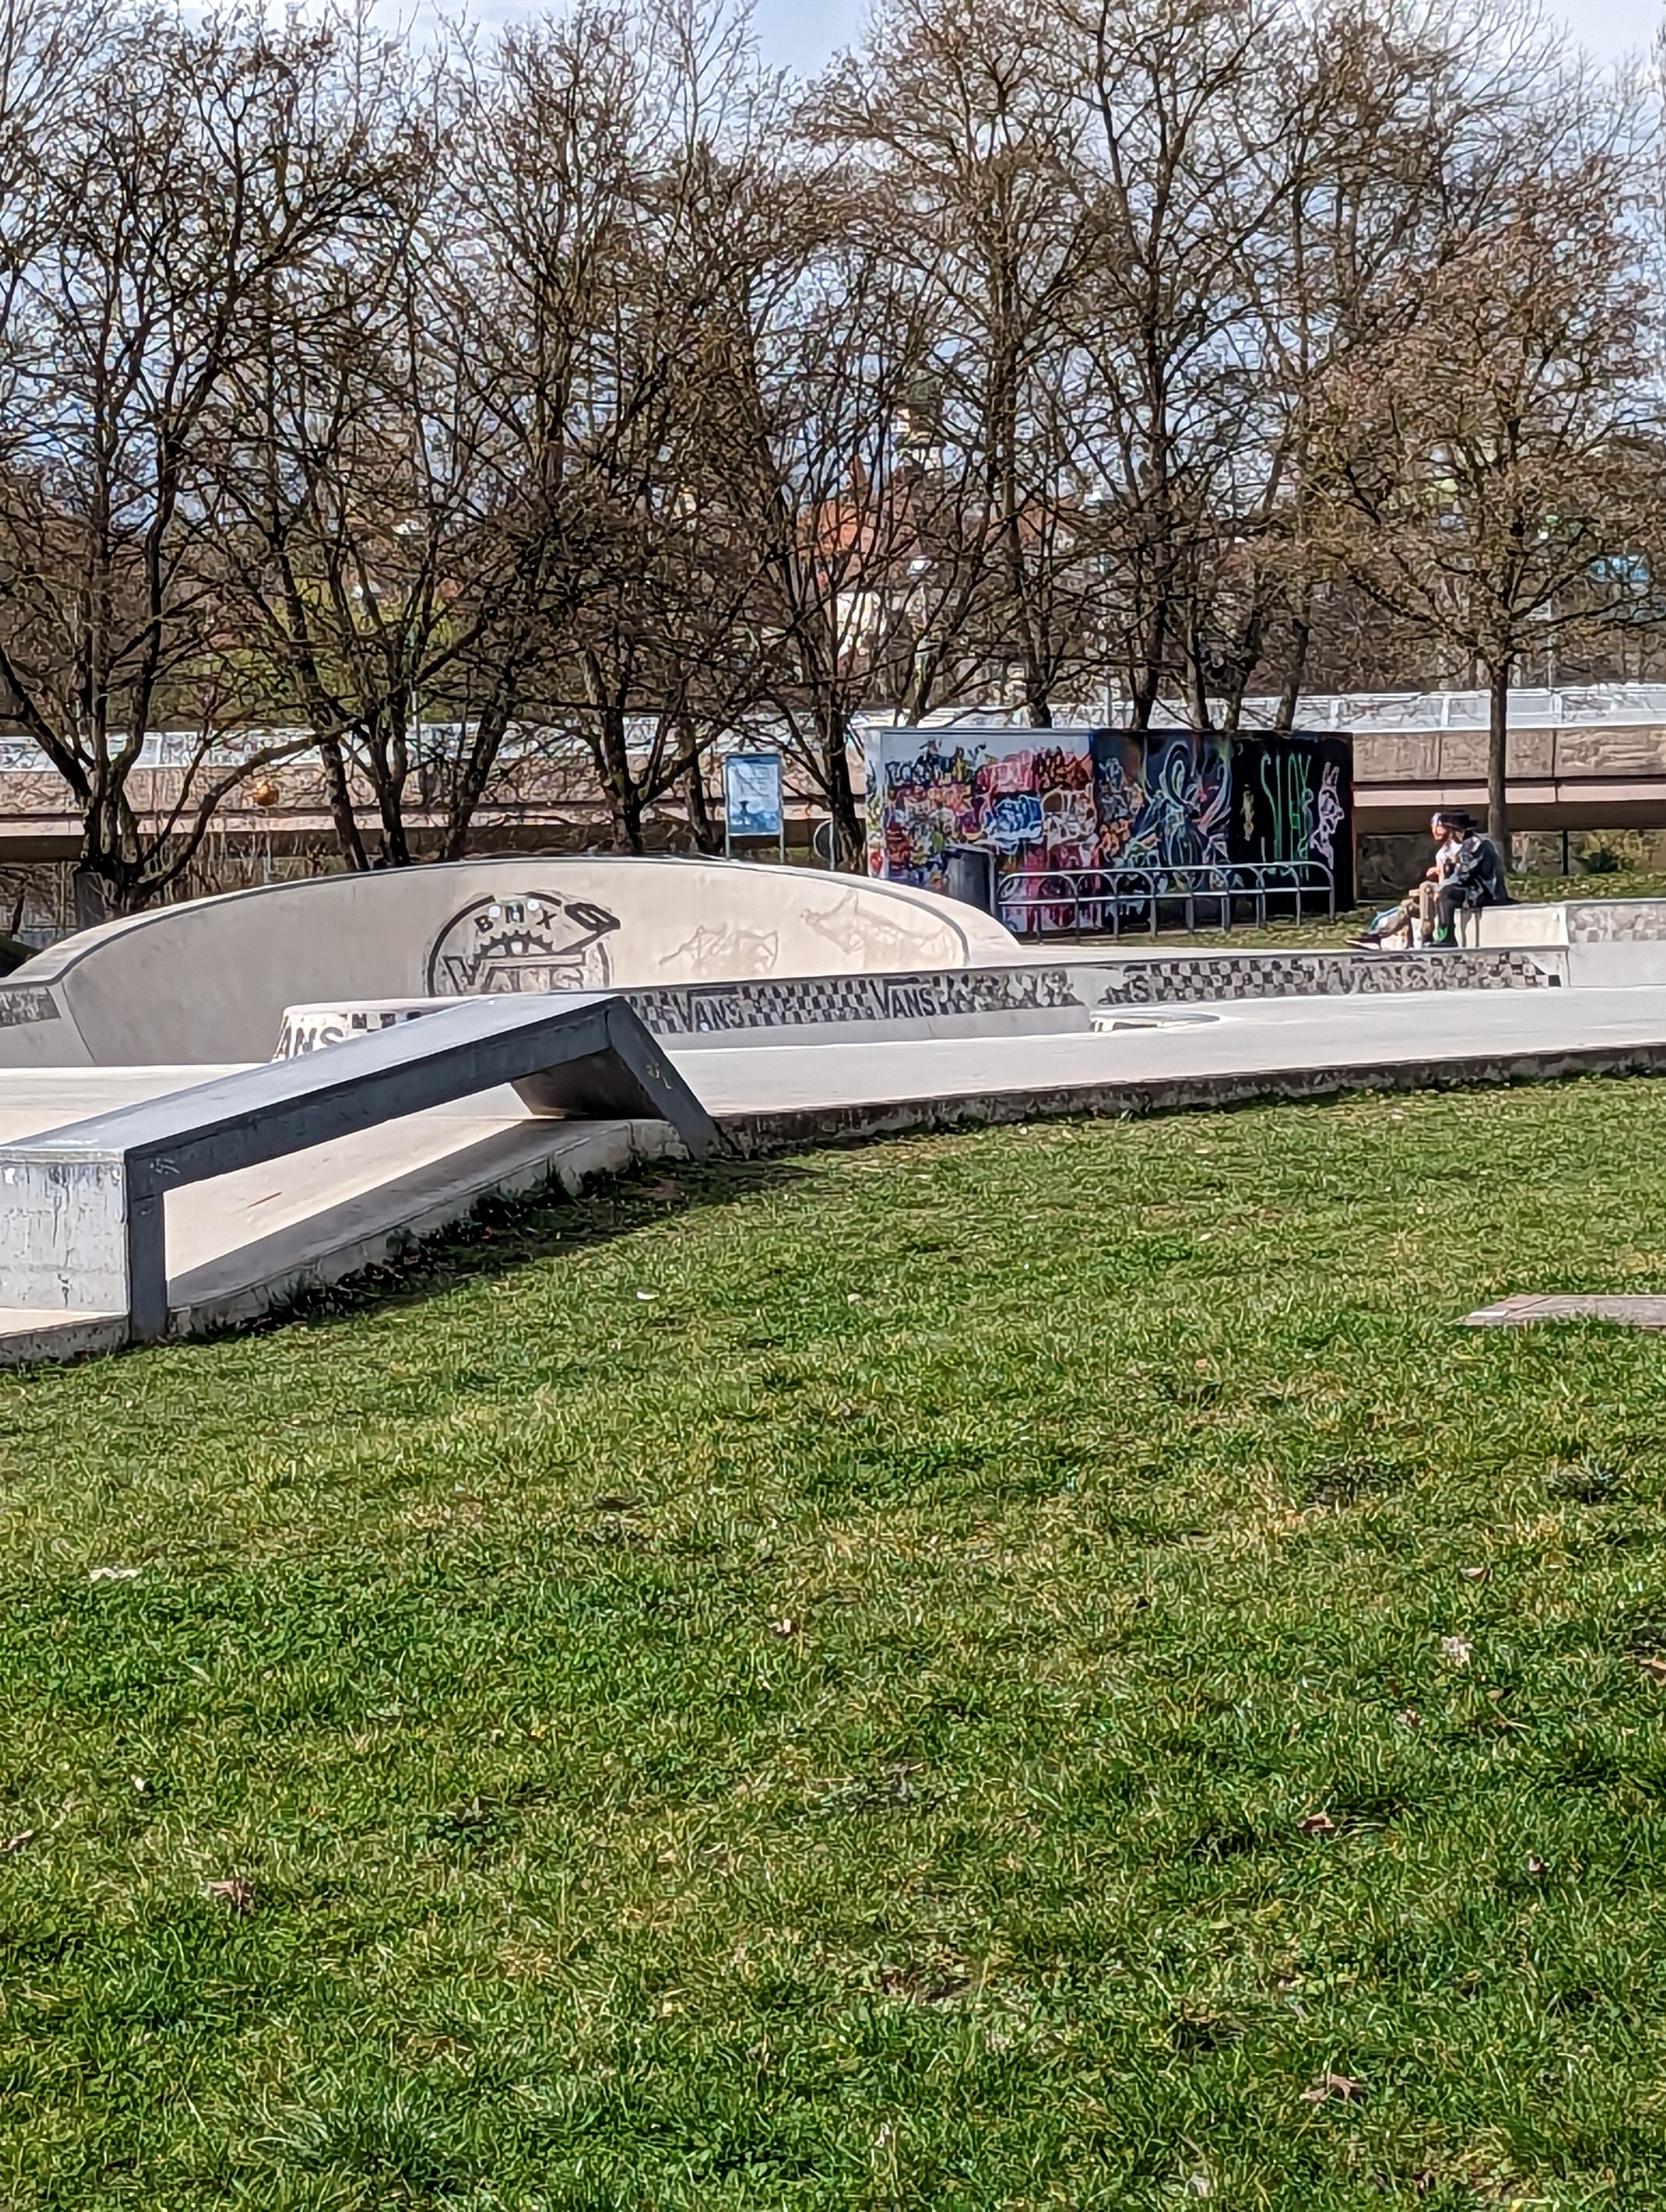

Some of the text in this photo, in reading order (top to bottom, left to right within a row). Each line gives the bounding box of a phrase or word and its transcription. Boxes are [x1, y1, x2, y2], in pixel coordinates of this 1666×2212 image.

[475, 903, 557, 934] BMX
[672, 986, 745, 1033] VANS
[868, 976, 936, 1019] VANS
